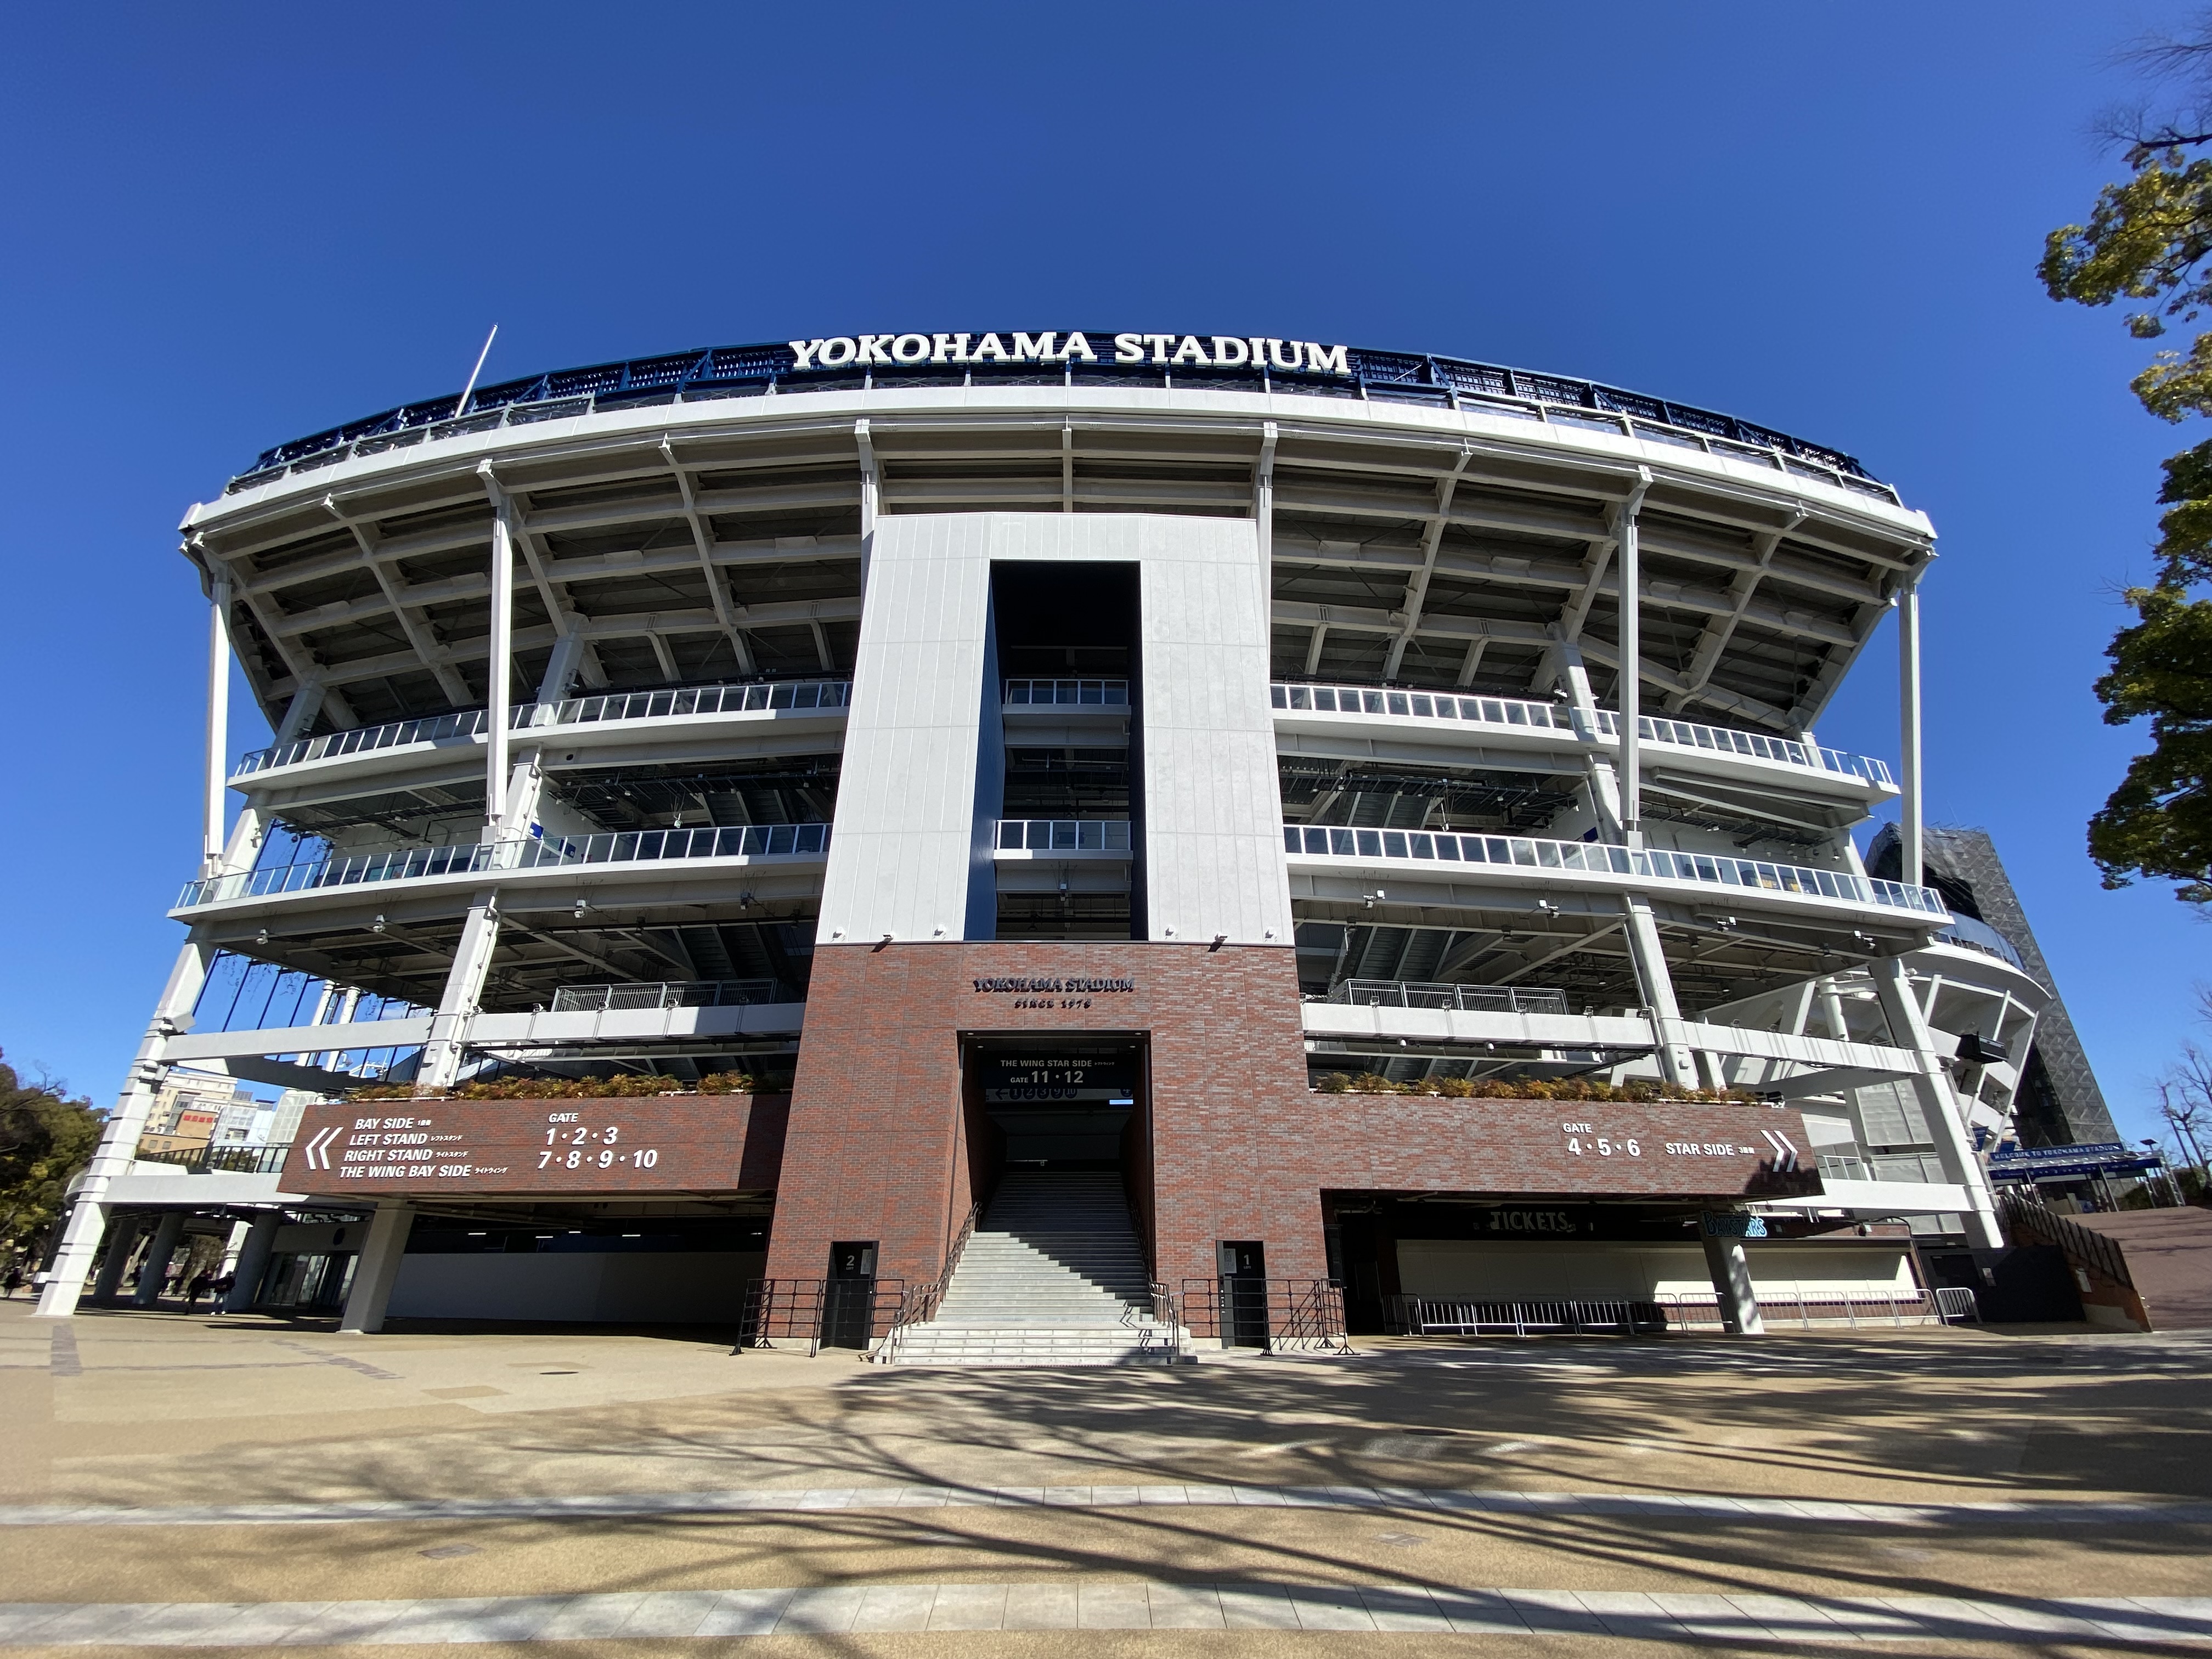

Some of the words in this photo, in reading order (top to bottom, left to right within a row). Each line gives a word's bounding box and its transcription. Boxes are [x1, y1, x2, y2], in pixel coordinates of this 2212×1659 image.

[789, 331, 1098, 370] YOKOHAMA
[1114, 333, 1351, 374] STADIUM
[974, 978, 1063, 992] YOKOHAMA
[1065, 978, 1135, 992] STADIUM
[354, 1119, 381, 1130] BAY
[383, 1118, 414, 1129] SIDE
[549, 1113, 579, 1123] GATE
[1563, 1123, 1592, 1133] GATE
[349, 1134, 381, 1146] LEFT
[382, 1133, 428, 1146] STAND
[345, 1150, 386, 1161] RIGHT
[387, 1149, 433, 1161] STAND
[1666, 1143, 1701, 1155] STAR
[1703, 1144, 1735, 1156] SIDE
[340, 1166, 366, 1178] THE
[368, 1166, 407, 1178] WING
[408, 1166, 437, 1177] BAY
[439, 1165, 472, 1177] SIDE
[1490, 1211, 1568, 1230] TICKETS
[847, 1255, 855, 1266] 2
[1244, 1254, 1249, 1265] 1
